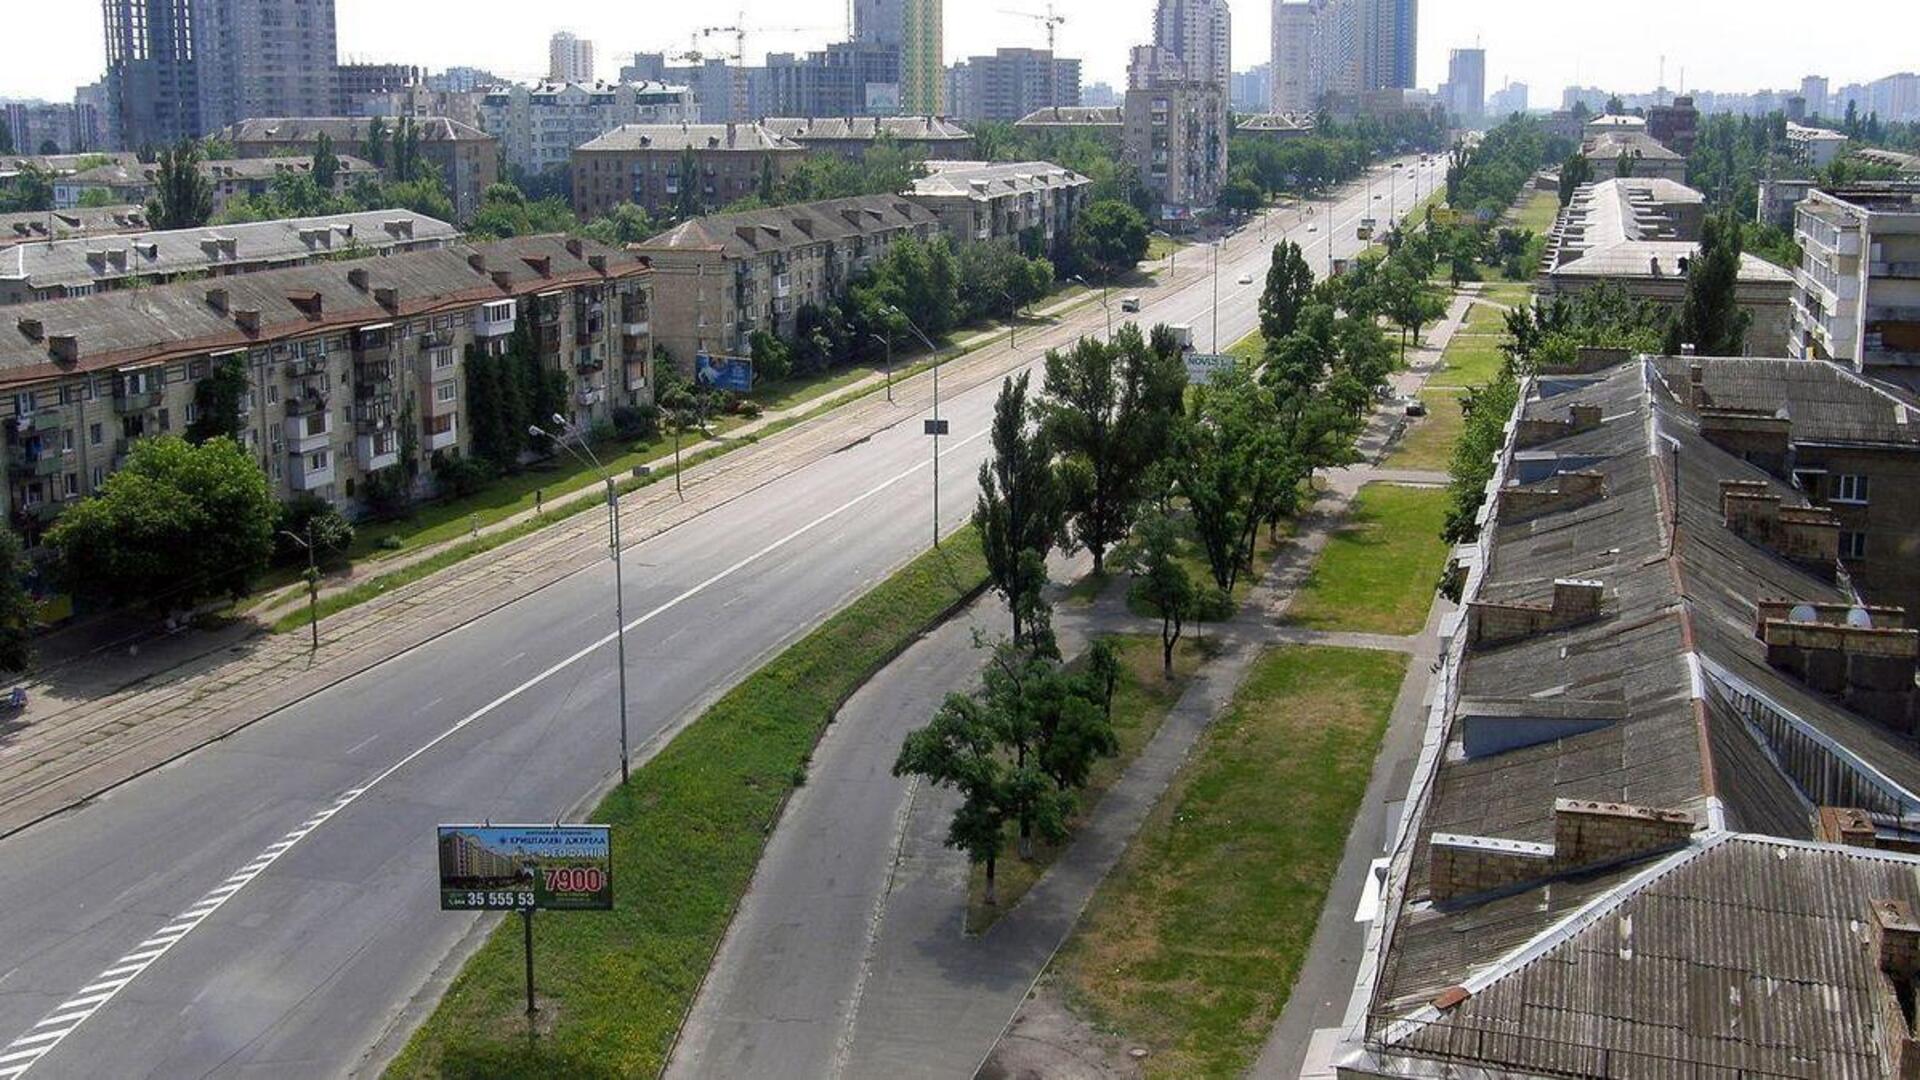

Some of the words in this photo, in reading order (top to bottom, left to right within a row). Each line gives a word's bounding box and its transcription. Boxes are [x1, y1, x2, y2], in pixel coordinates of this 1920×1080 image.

[545, 867, 602, 892] 7900
[467, 892, 485, 906] 35
[489, 892, 514, 906] 555
[518, 892, 535, 906] 53
